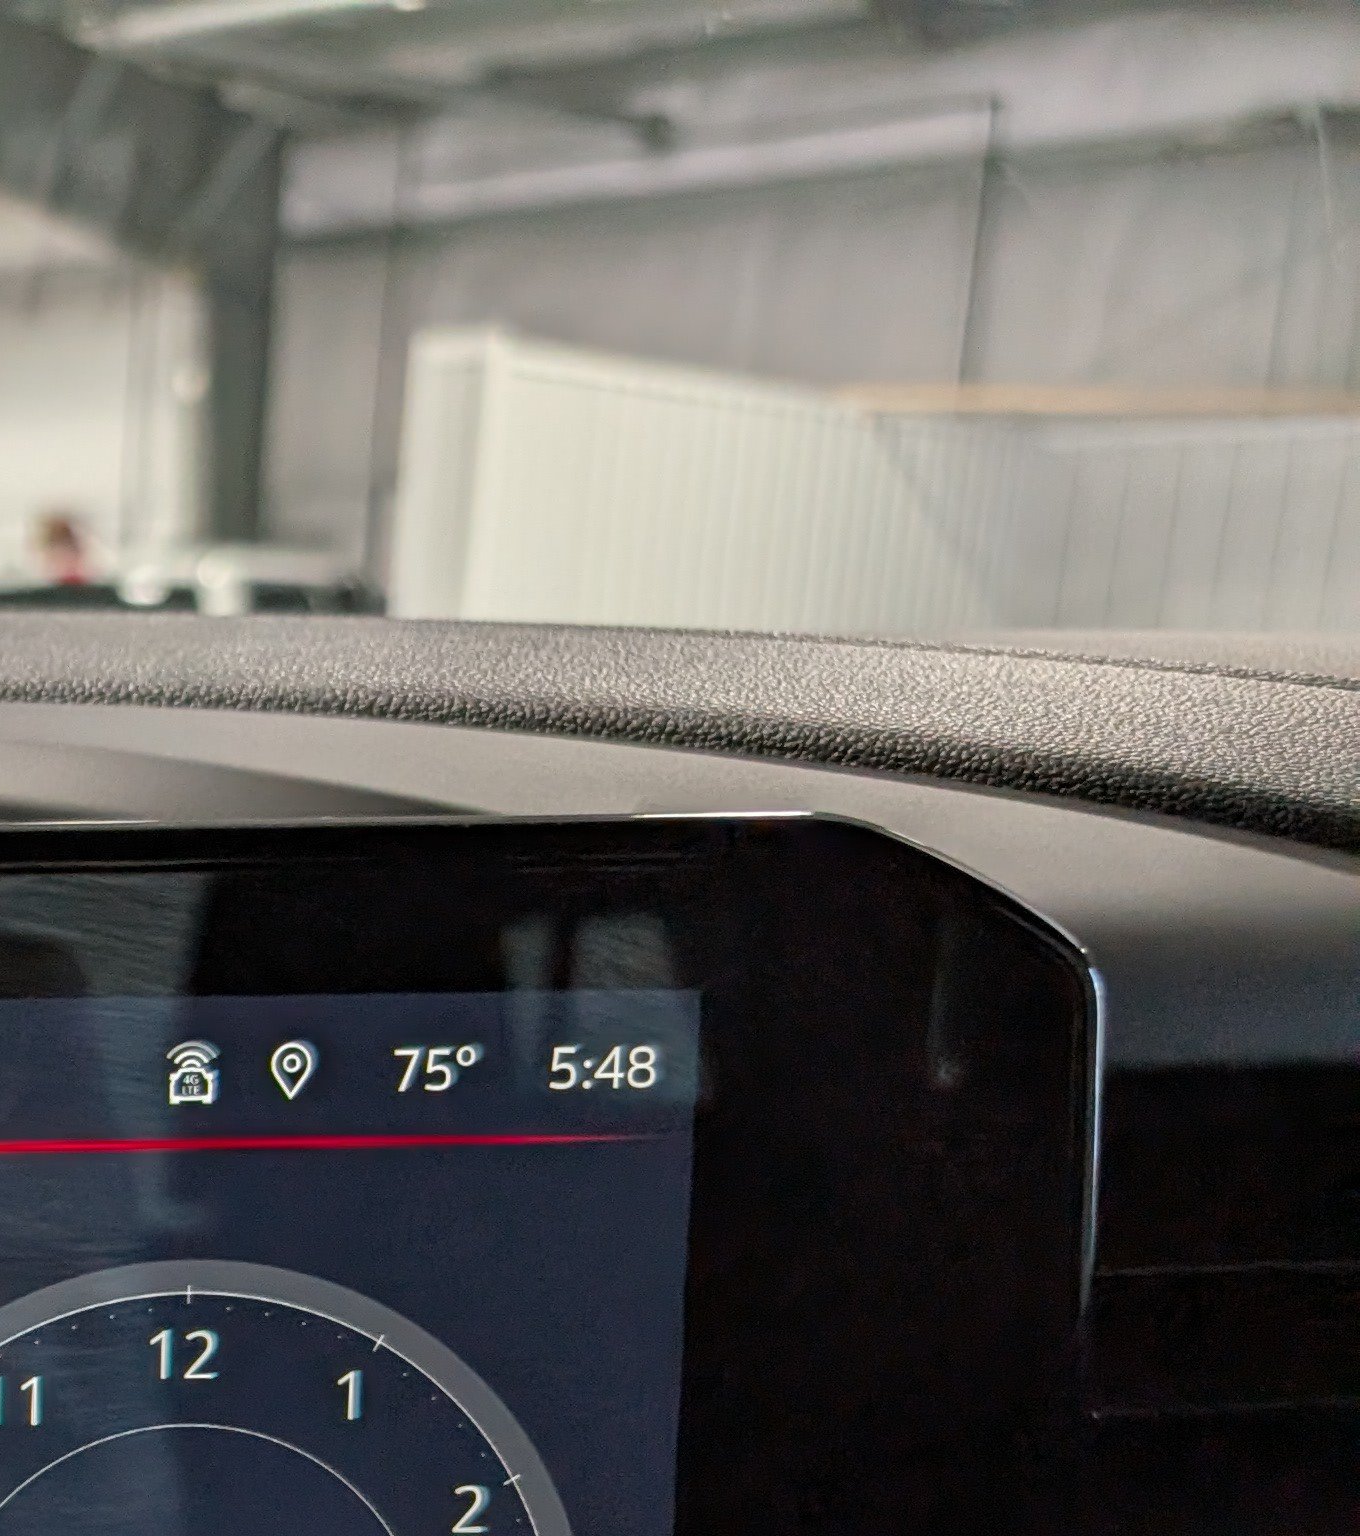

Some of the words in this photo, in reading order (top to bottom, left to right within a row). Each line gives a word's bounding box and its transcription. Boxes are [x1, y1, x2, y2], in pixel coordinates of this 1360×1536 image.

[550, 1046, 656, 1089] 5:48
[150, 1330, 217, 1379] 12
[338, 1371, 359, 1420] 1
[452, 1485, 487, 1533] 2
